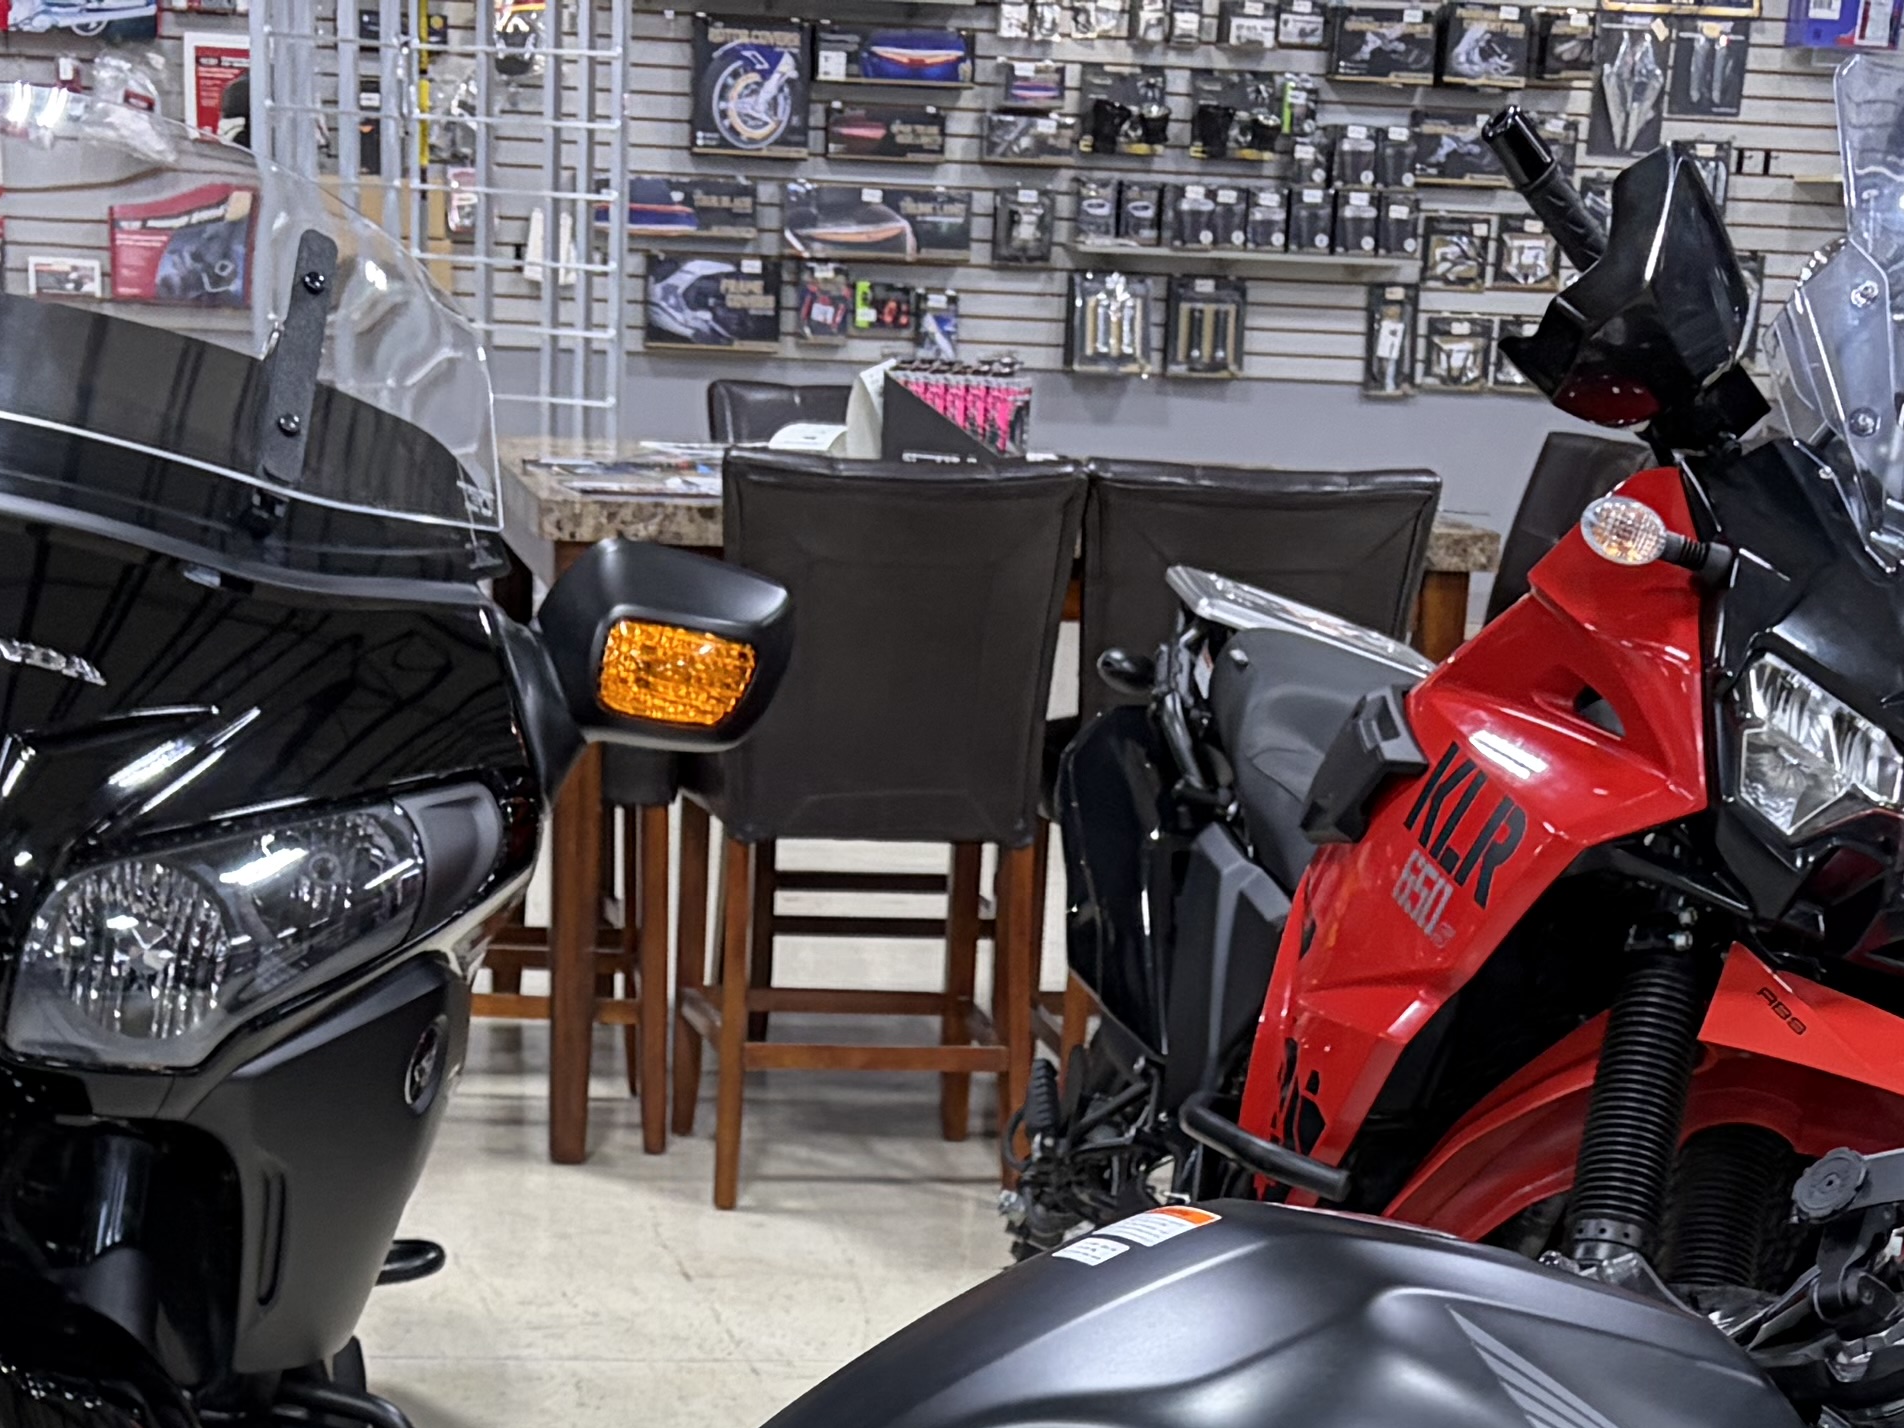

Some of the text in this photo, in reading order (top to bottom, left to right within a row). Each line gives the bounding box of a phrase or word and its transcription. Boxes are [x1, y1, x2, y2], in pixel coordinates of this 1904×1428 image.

[1402, 740, 1528, 911] KLR
[1392, 848, 1454, 936] 650
[1756, 986, 1808, 1036] ABS
